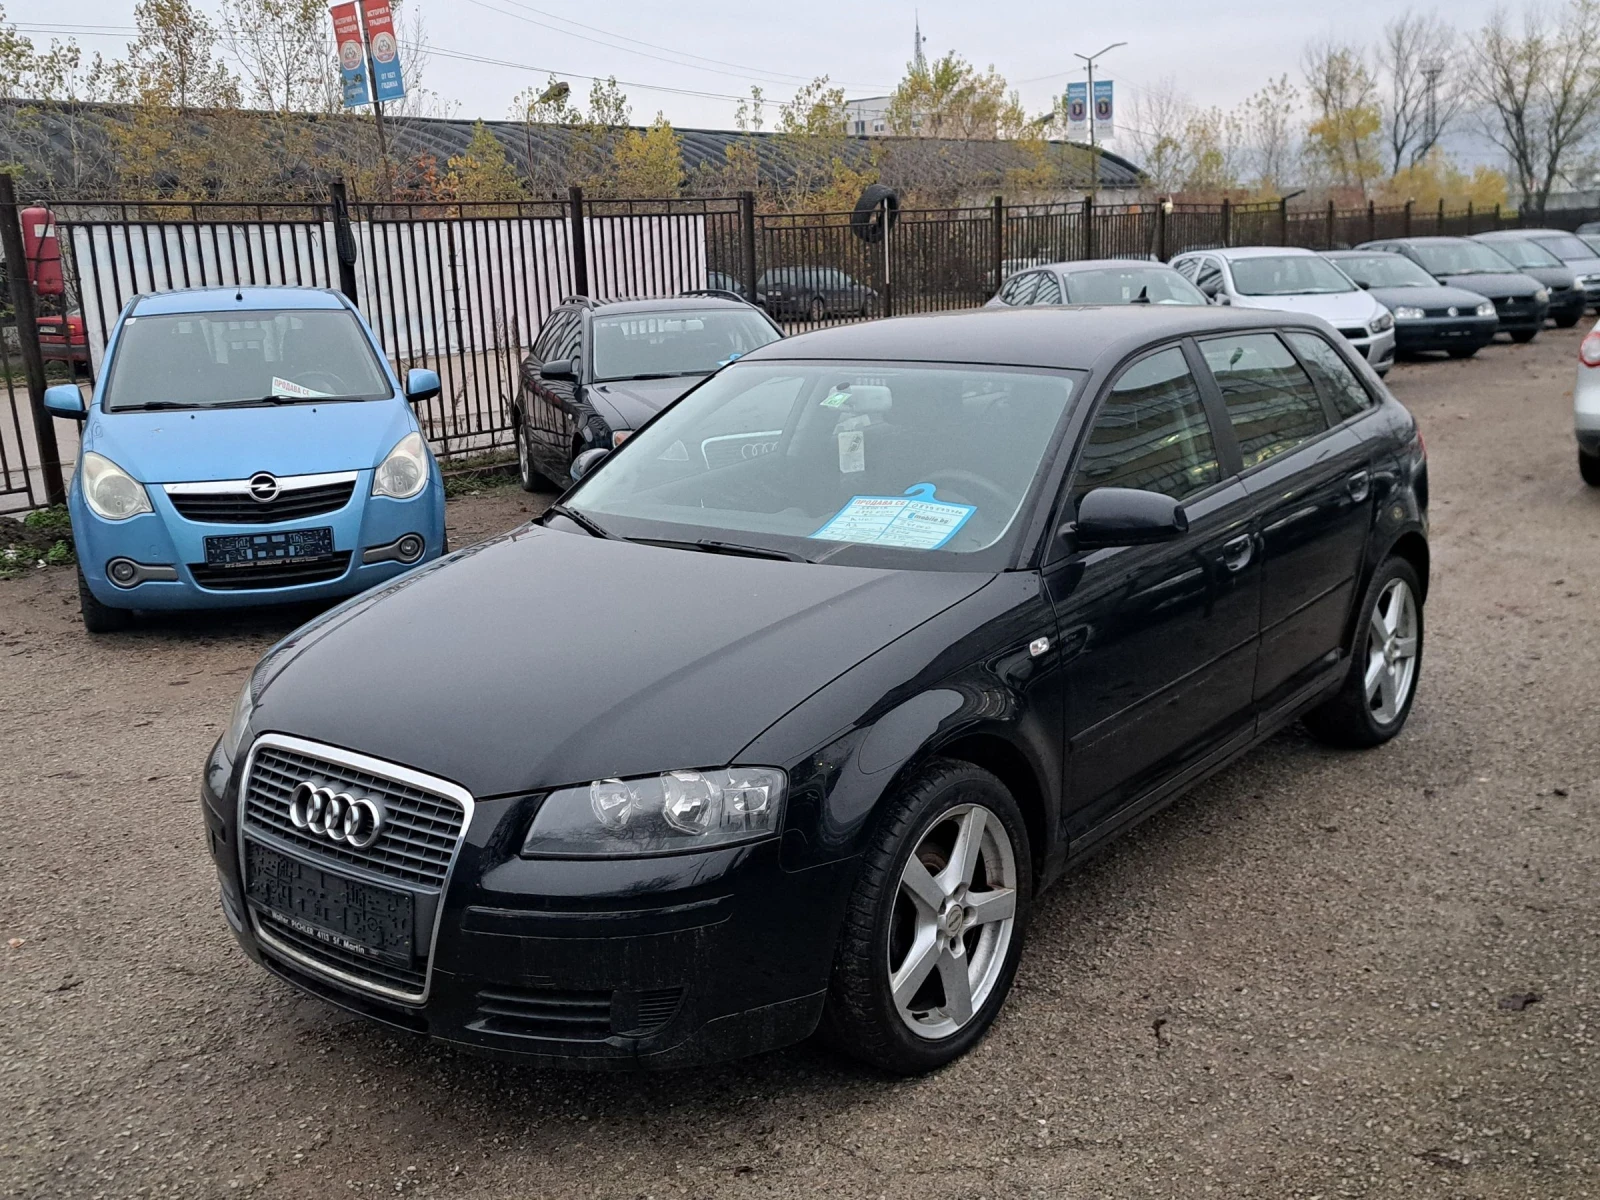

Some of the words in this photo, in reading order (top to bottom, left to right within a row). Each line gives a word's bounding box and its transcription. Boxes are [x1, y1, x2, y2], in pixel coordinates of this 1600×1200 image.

[274, 379, 301, 394] ПРОДАВА
[914, 513, 950, 524] mobile.bg
[291, 919, 314, 936] PICHLER
[316, 930, 330, 942] 4113
[343, 939, 365, 954] Martin
